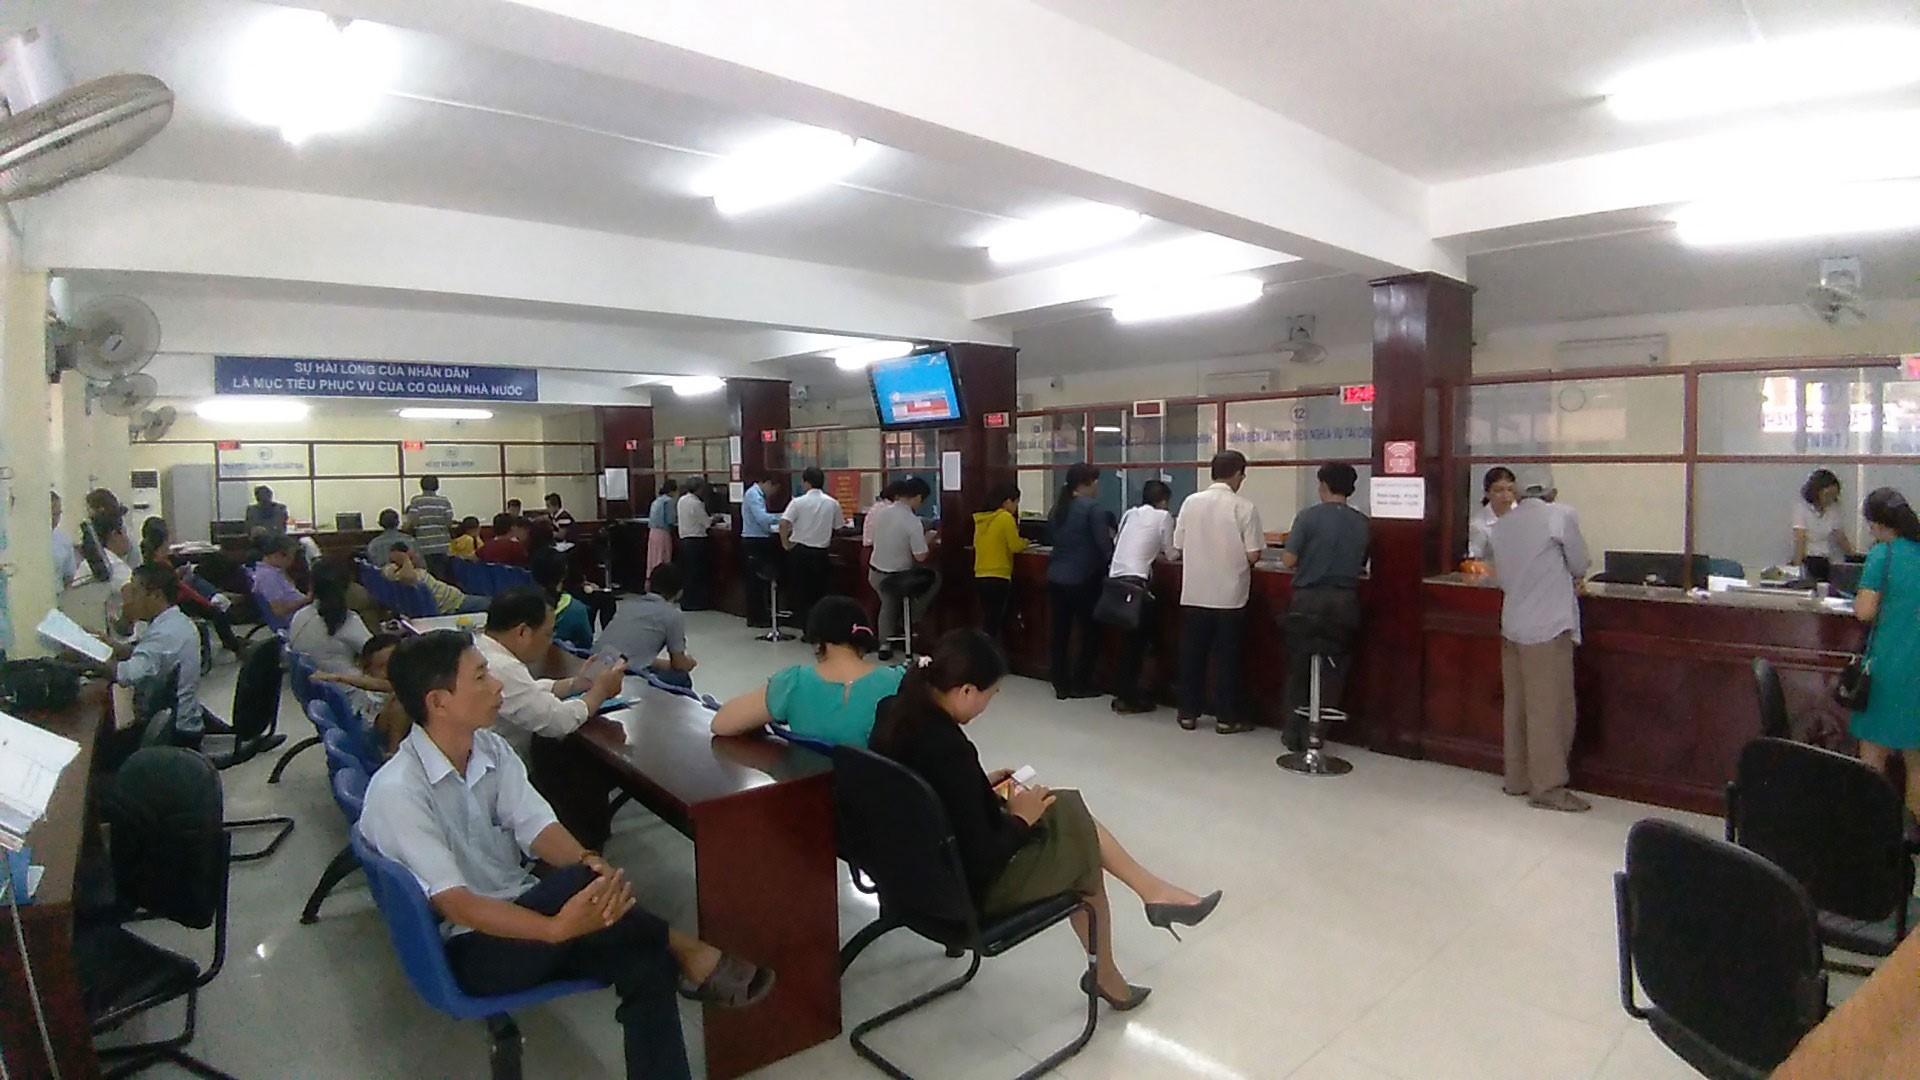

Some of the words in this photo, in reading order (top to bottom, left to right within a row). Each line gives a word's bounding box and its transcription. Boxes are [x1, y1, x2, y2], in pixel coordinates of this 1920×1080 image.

[294, 361, 313, 375] SỰ
[316, 361, 338, 374] HÀI
[341, 363, 375, 375] LÒNG
[378, 363, 404, 376] CỦA
[408, 365, 442, 378] NHÂN
[445, 366, 469, 378] DÂN
[233, 375, 250, 388] LÀ
[254, 378, 283, 390] MỤC
[286, 375, 316, 390] TIÊU
[320, 379, 355, 392] PHỤC
[357, 380, 376, 392] VỤ
[378, 378, 404, 392] CỦA
[407, 381, 425, 392] CƠ
[428, 382, 461, 394] QUAN
[465, 382, 488, 395] NHÀ
[491, 384, 523, 396] NƯỚC
[1293, 408, 1306, 420] 12
